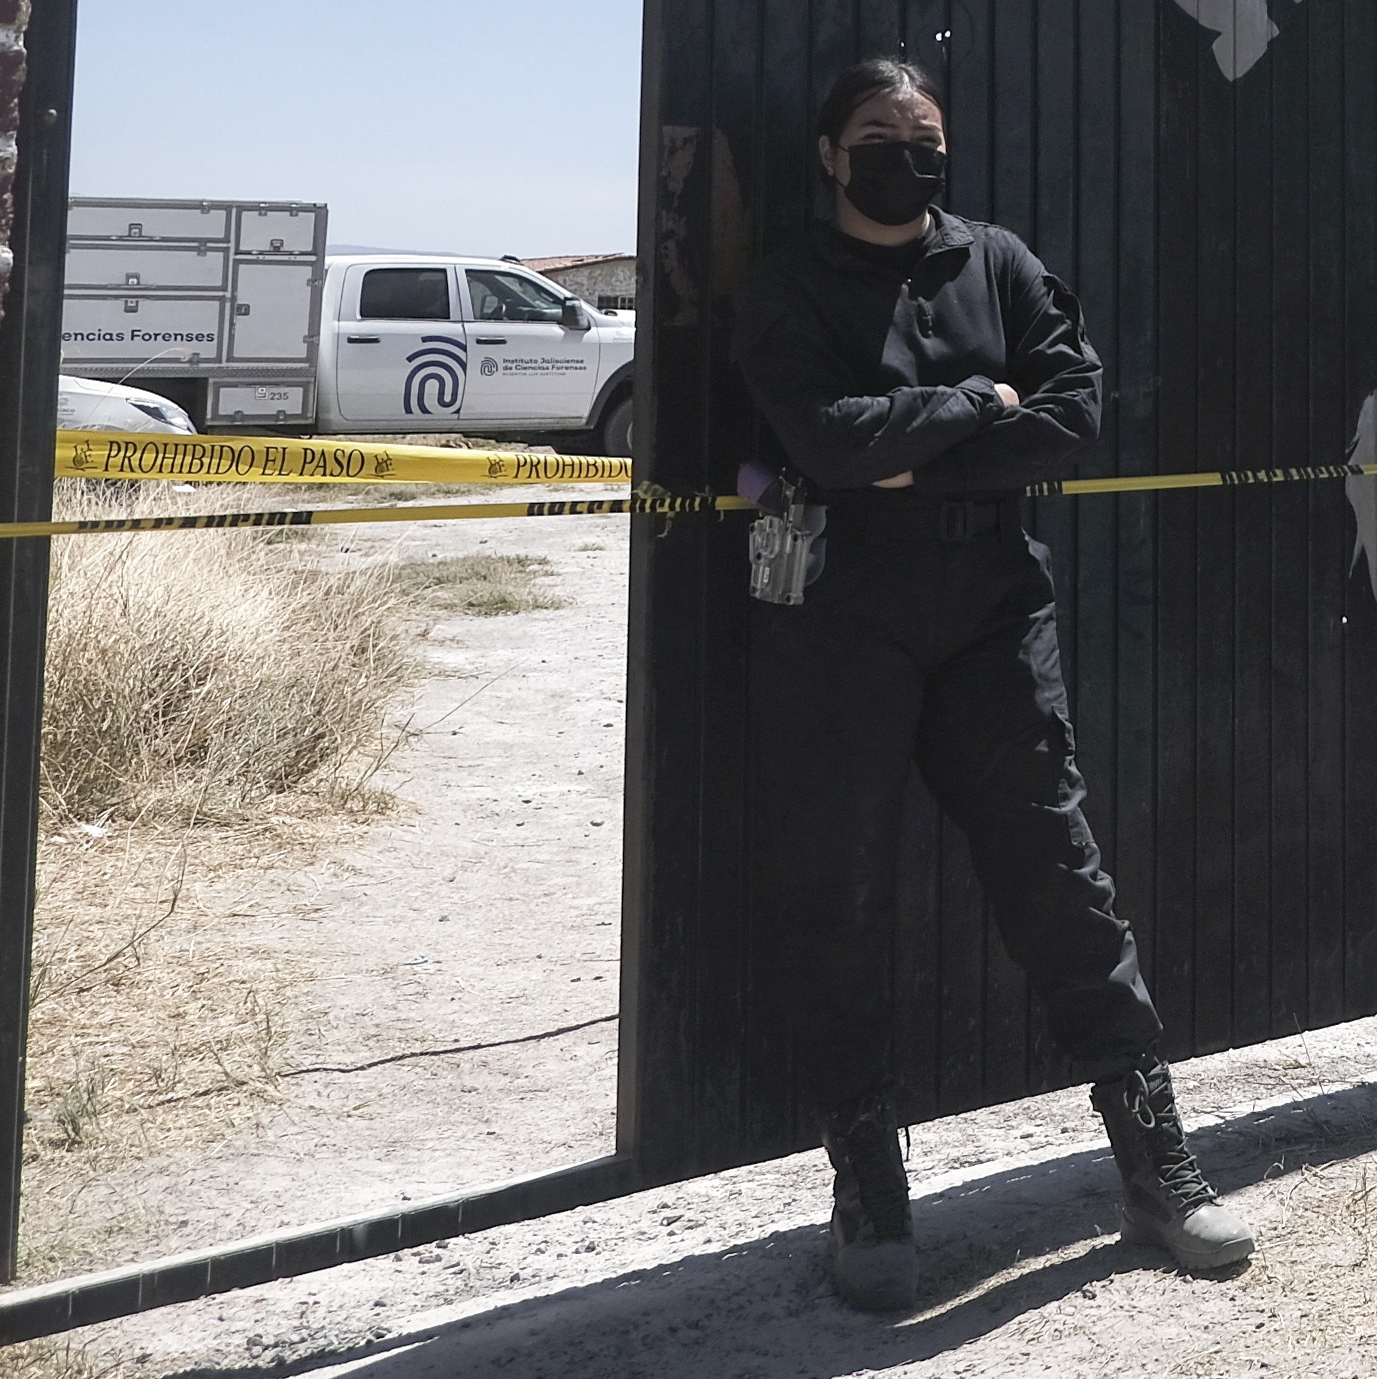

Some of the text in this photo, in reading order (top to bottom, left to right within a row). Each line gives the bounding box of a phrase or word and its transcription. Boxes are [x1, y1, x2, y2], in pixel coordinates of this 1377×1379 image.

[62, 329, 215, 343] encias Forenses
[270, 392, 289, 401] 235
[103, 440, 256, 476] PROHIBIDO
[261, 446, 293, 477] EL
[299, 447, 366, 478] PASO
